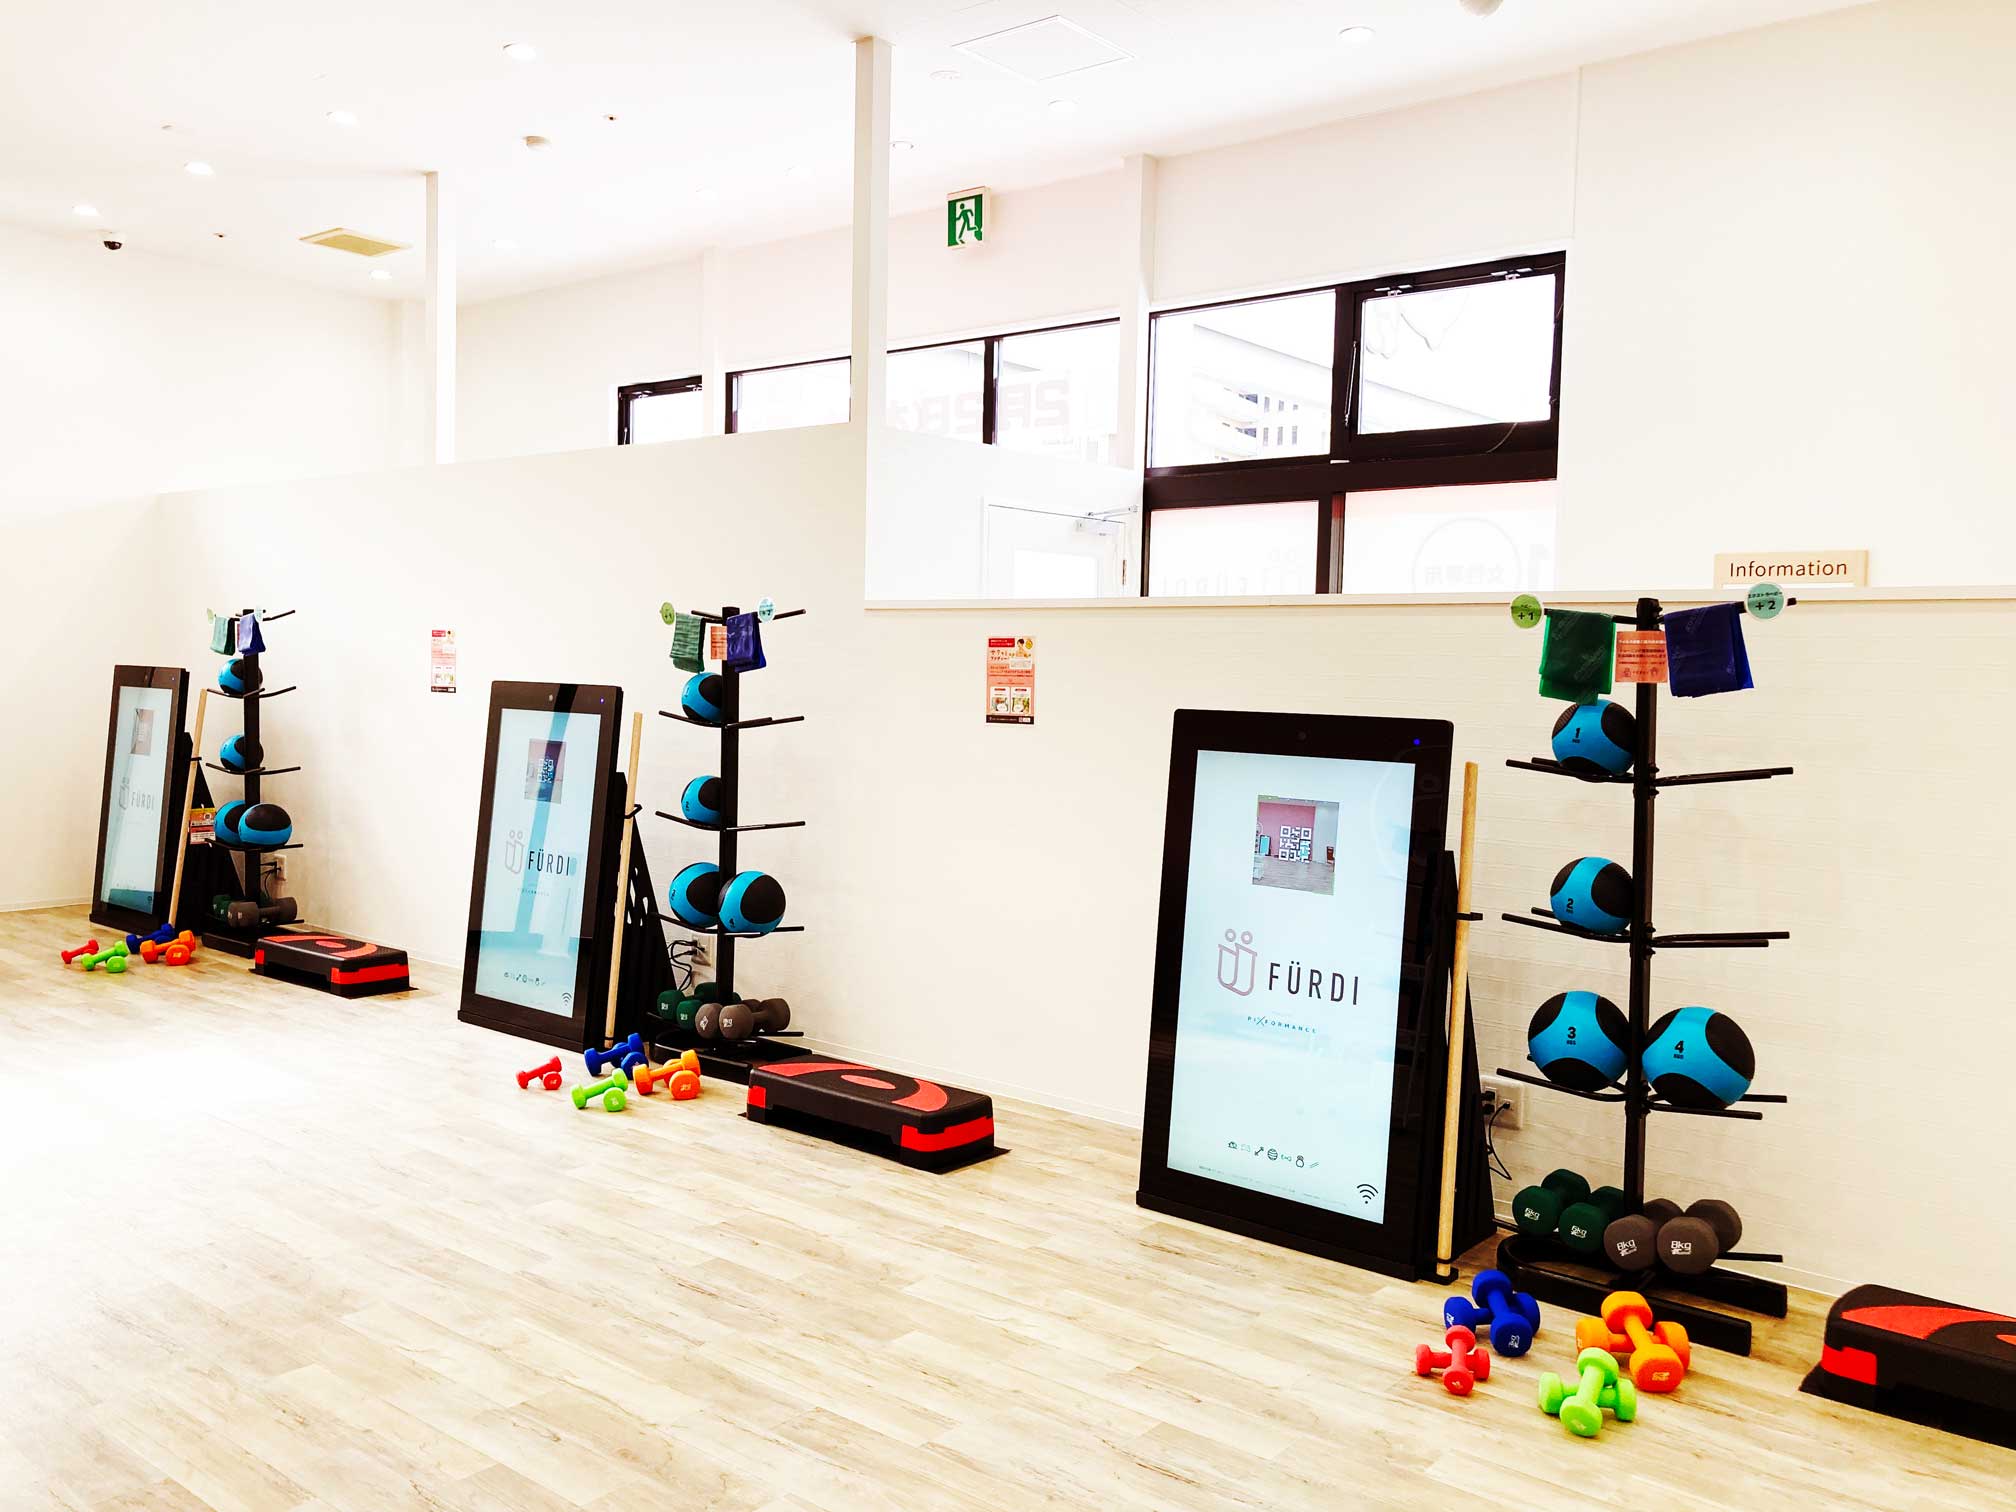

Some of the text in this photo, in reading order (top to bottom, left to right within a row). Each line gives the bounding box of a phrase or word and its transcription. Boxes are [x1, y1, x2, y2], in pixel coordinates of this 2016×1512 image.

[1730, 560, 1847, 577] Information
[1575, 727, 1581, 738] 1
[528, 848, 571, 876] FÜRDI
[1566, 898, 1574, 909] 2
[1268, 960, 1359, 1005] FÜRDI
[1567, 1026, 1577, 1039] 3
[1674, 1040, 1684, 1053] 4
[1670, 1240, 1692, 1251] 8kg
